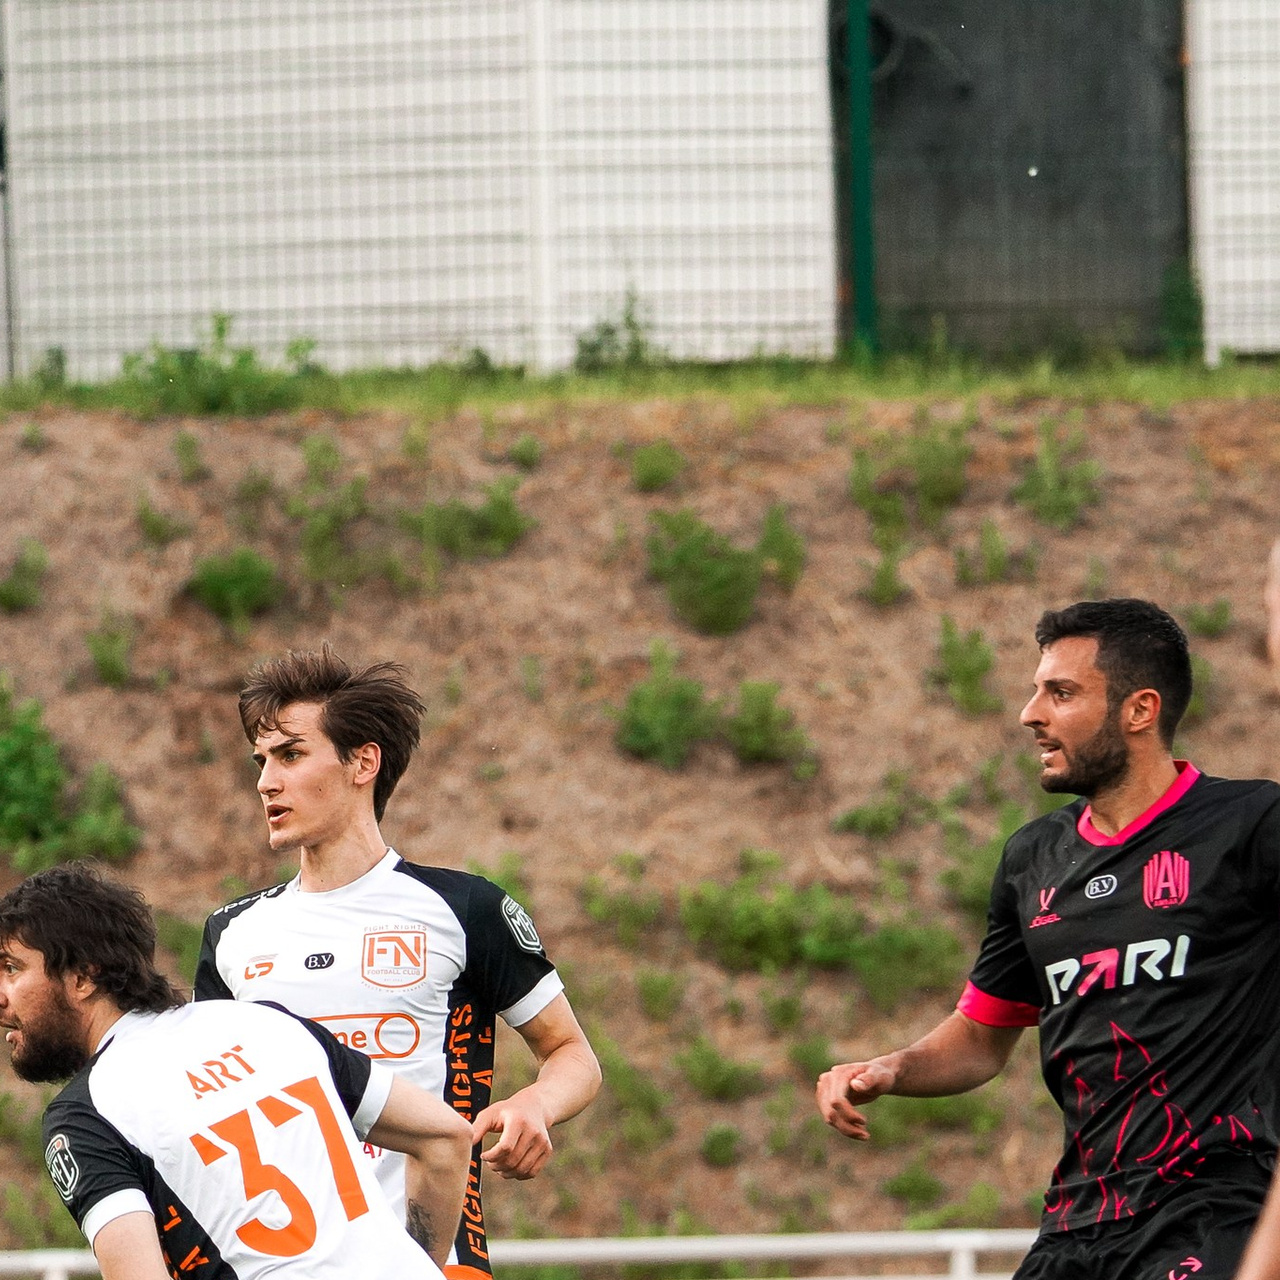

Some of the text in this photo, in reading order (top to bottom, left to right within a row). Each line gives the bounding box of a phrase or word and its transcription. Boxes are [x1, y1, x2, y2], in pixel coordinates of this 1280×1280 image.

[185, 1044, 256, 1100] ART
[449, 1003, 472, 1121] IGHTS
[189, 1075, 370, 1257] 37
